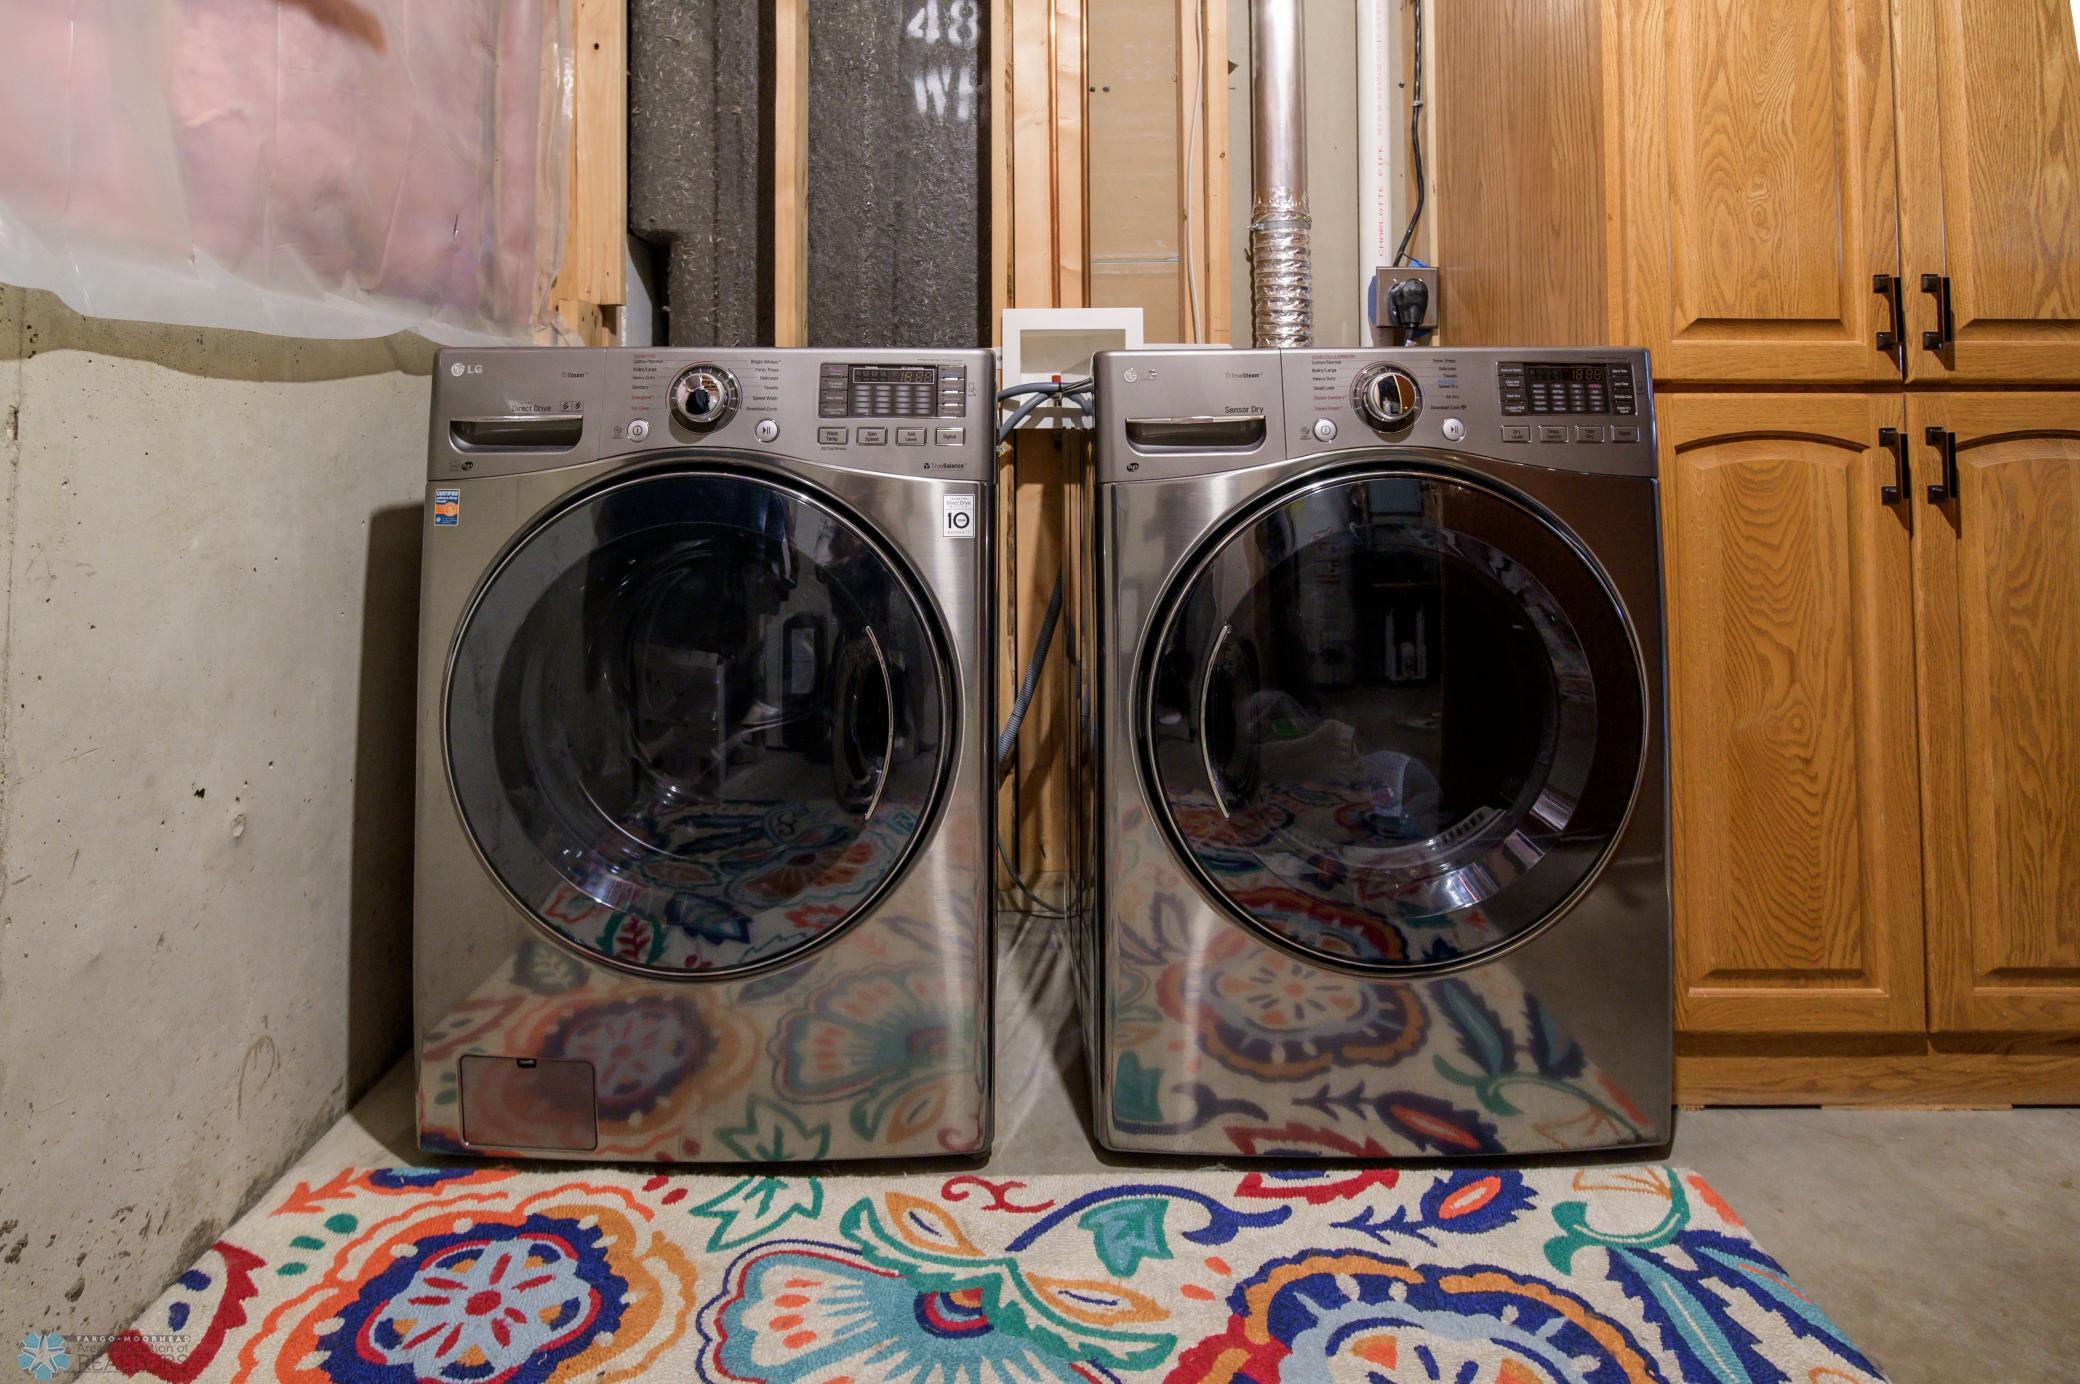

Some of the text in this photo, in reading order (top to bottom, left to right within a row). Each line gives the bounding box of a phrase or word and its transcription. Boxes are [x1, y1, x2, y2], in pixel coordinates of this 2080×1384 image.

[467, 364, 483, 374] LG
[512, 404, 532, 412] Direct
[533, 404, 552, 412] Drive
[1224, 405, 1265, 414] Sensor Dry
[947, 511, 970, 529] 10
